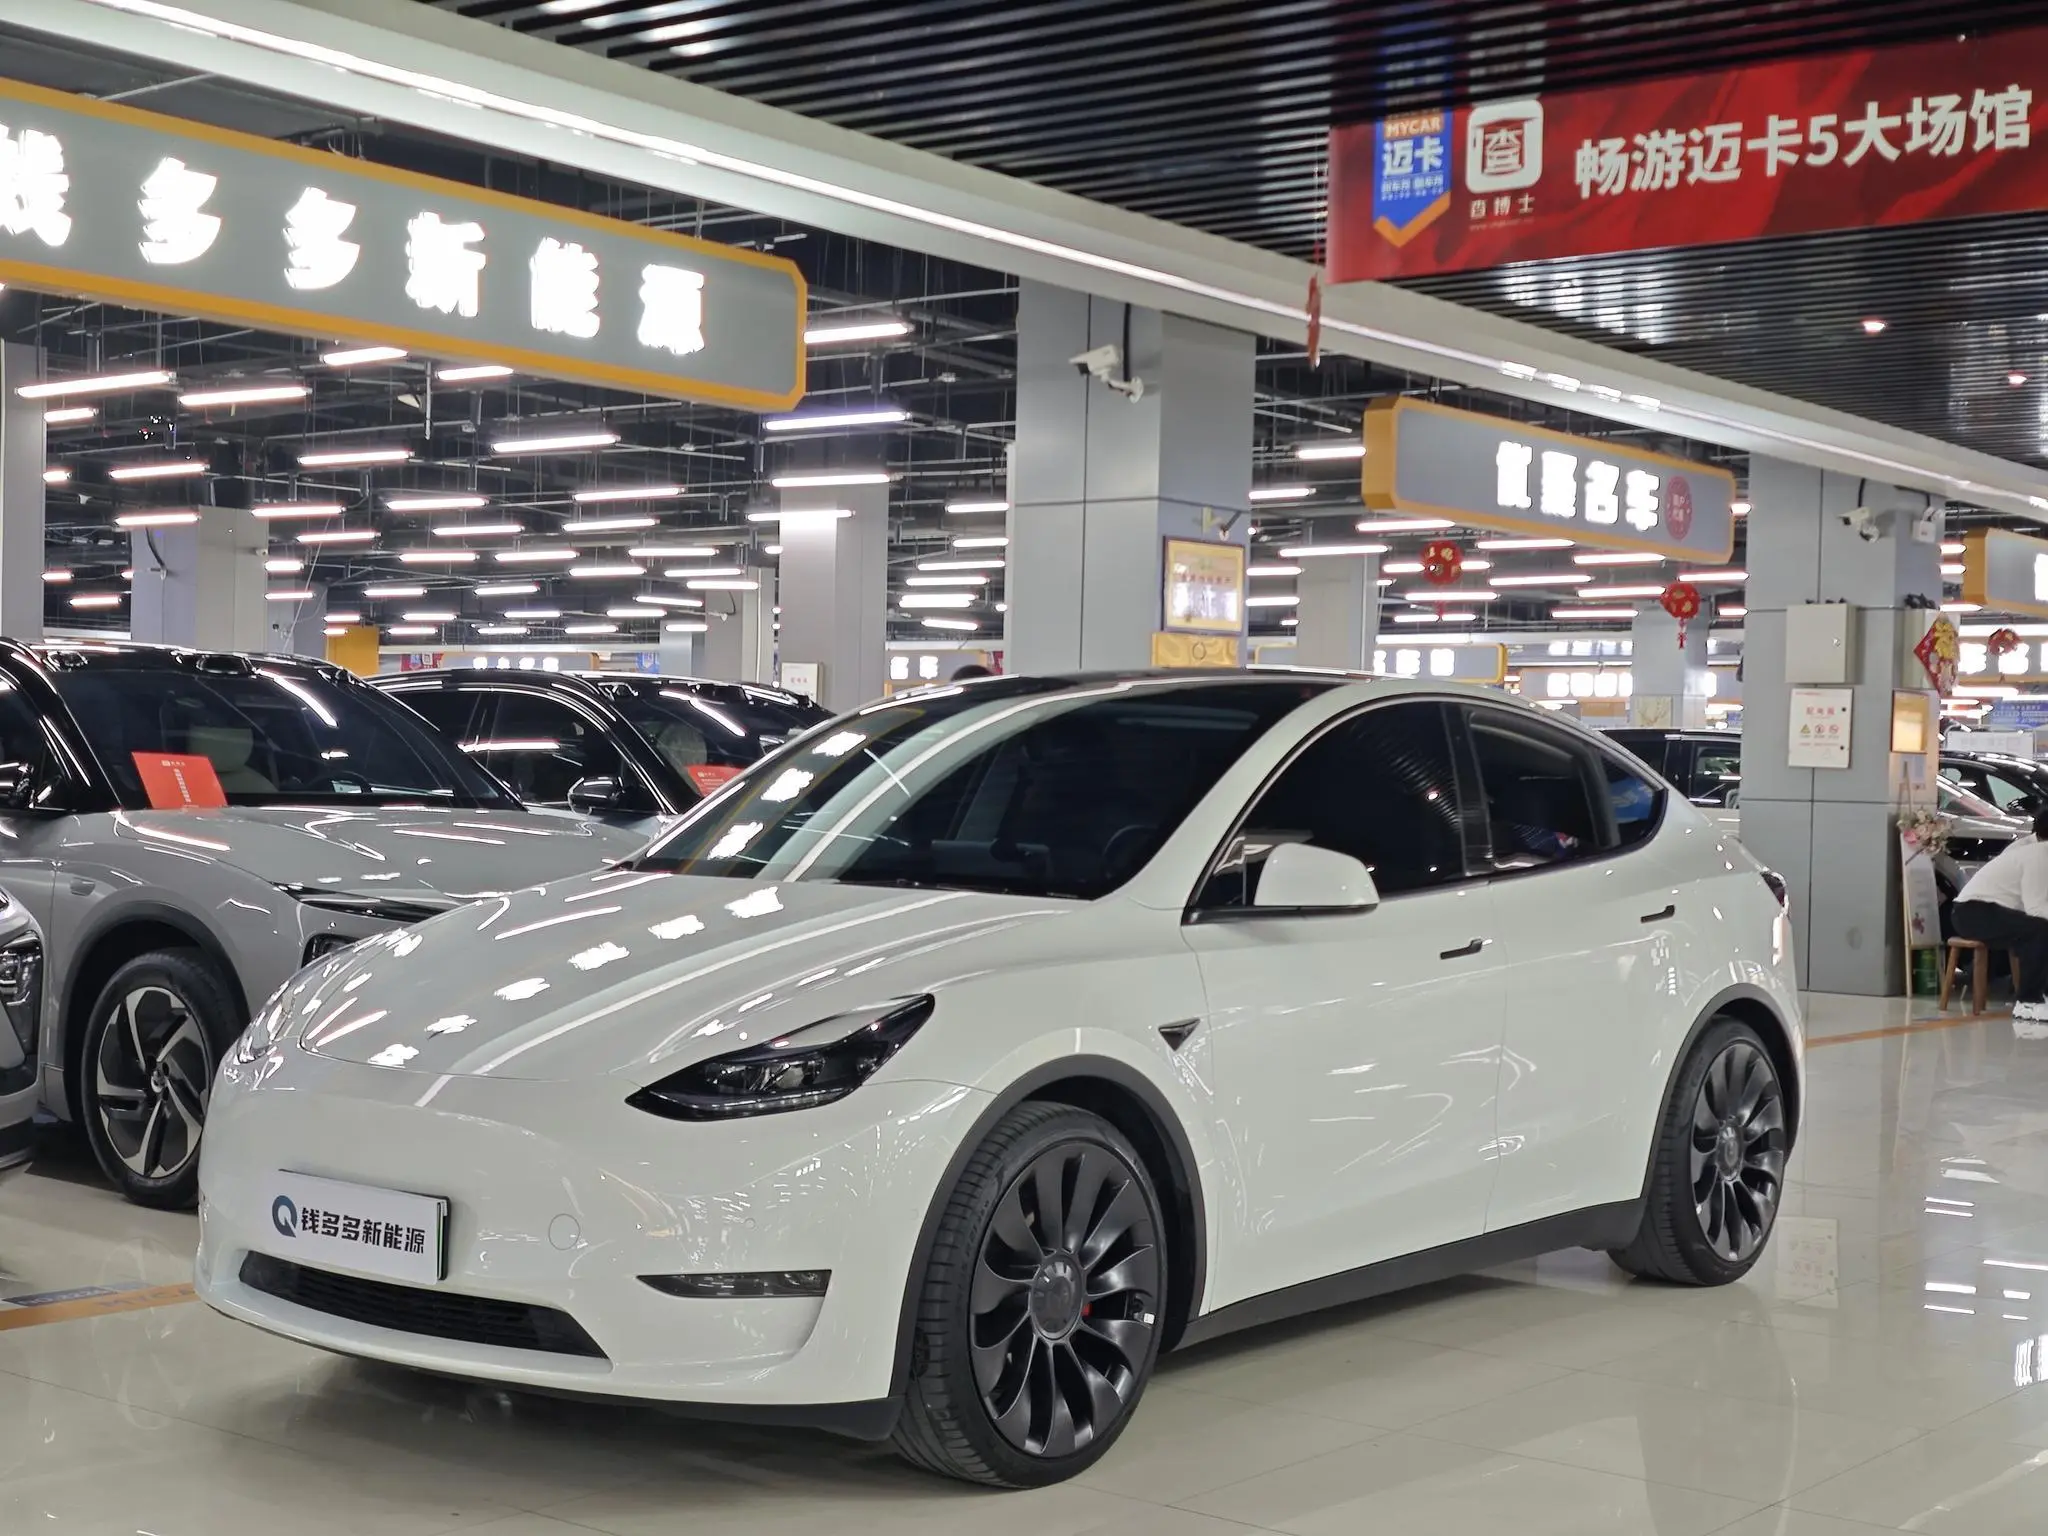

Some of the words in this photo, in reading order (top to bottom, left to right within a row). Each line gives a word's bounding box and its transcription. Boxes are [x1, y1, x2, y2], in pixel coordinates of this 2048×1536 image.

[1386, 117, 1441, 137] MYCAR
[1575, 84, 2032, 199] 畅游迈卡5大场馆
[1383, 137, 1444, 176] 迈卡
[301, 1206, 426, 1255] 钱多多新能源
